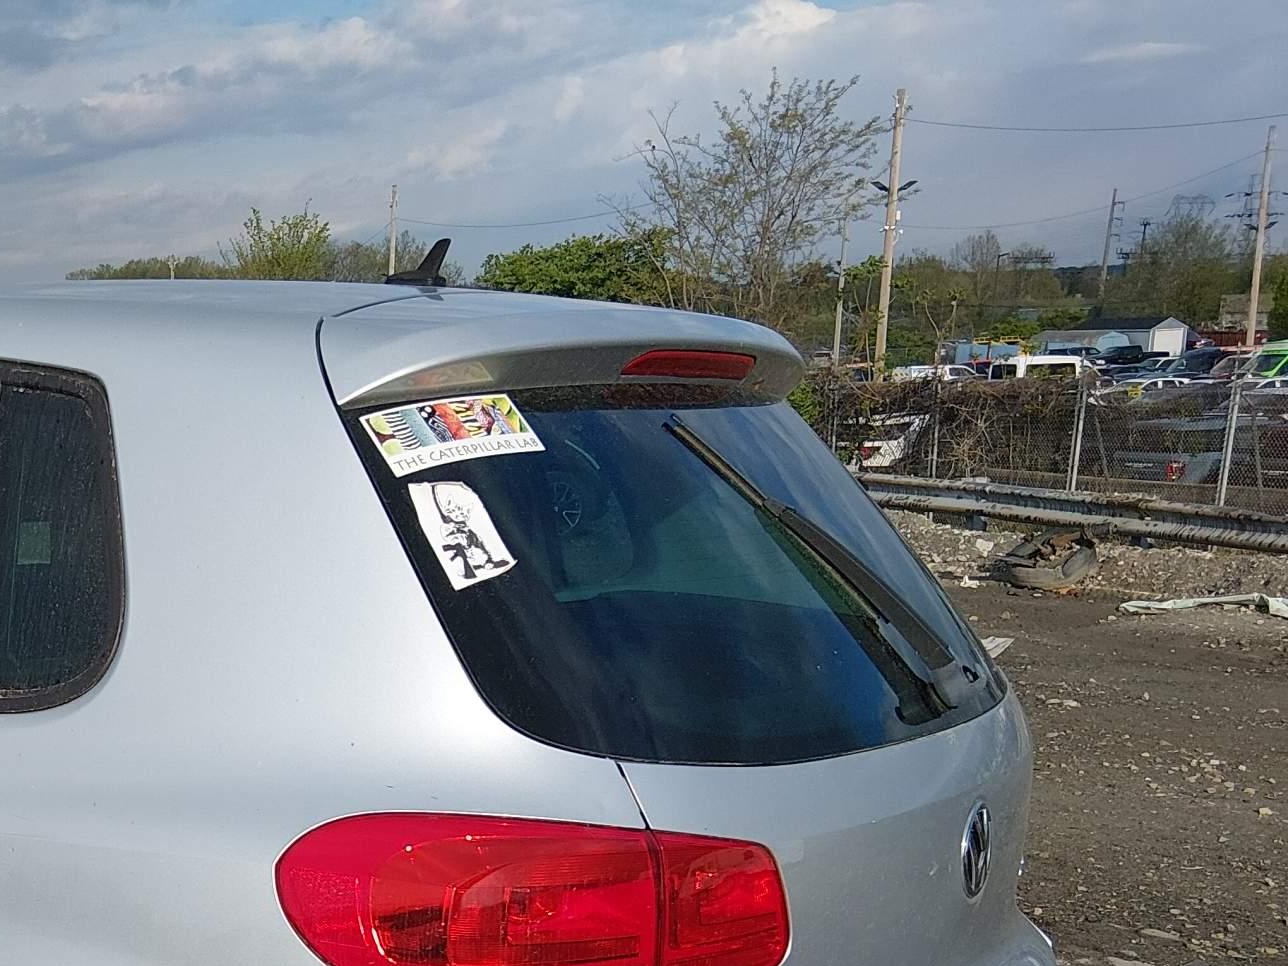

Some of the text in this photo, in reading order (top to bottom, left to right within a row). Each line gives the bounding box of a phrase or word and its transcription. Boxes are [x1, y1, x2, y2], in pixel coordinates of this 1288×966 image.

[393, 437, 539, 471] THE CATERPILLAR LAB
